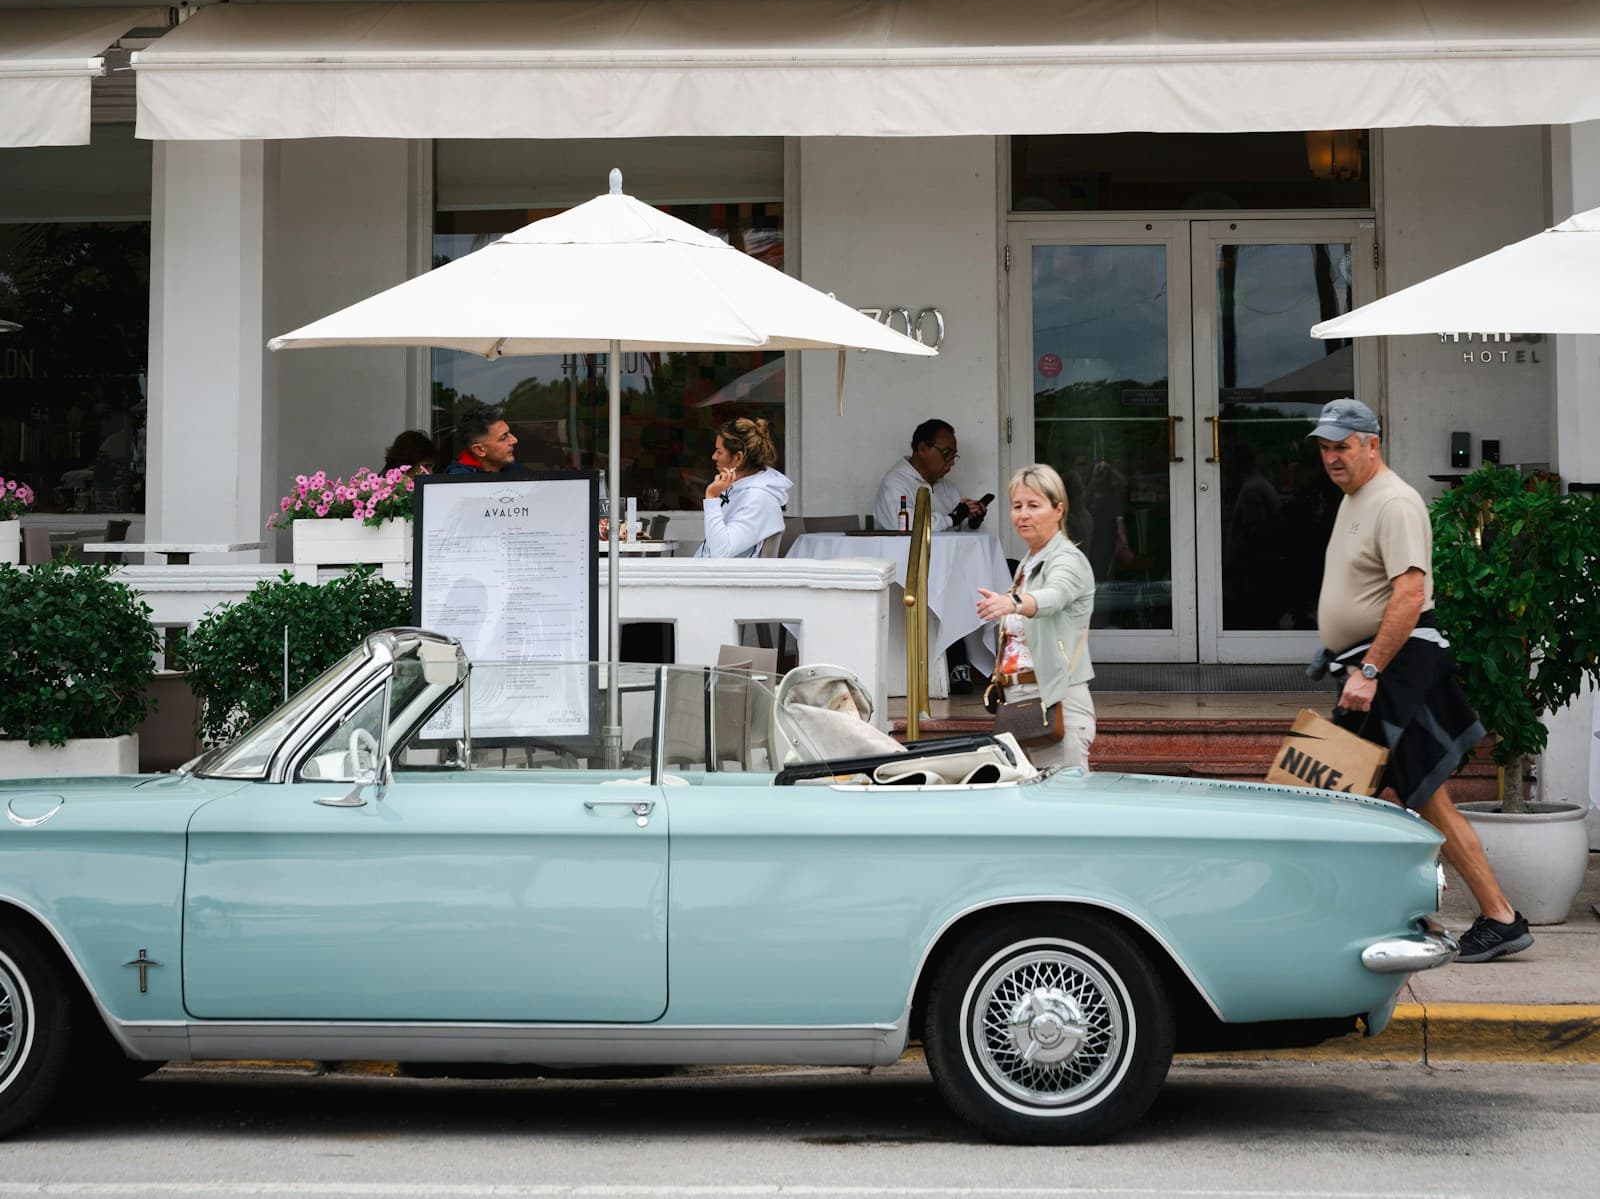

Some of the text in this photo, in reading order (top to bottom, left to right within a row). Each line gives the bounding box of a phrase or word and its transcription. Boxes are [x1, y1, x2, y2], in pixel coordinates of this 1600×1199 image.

[1463, 350, 1541, 364] HOTEL
[484, 506, 529, 518] AVALON
[1279, 746, 1343, 790] NIKE
